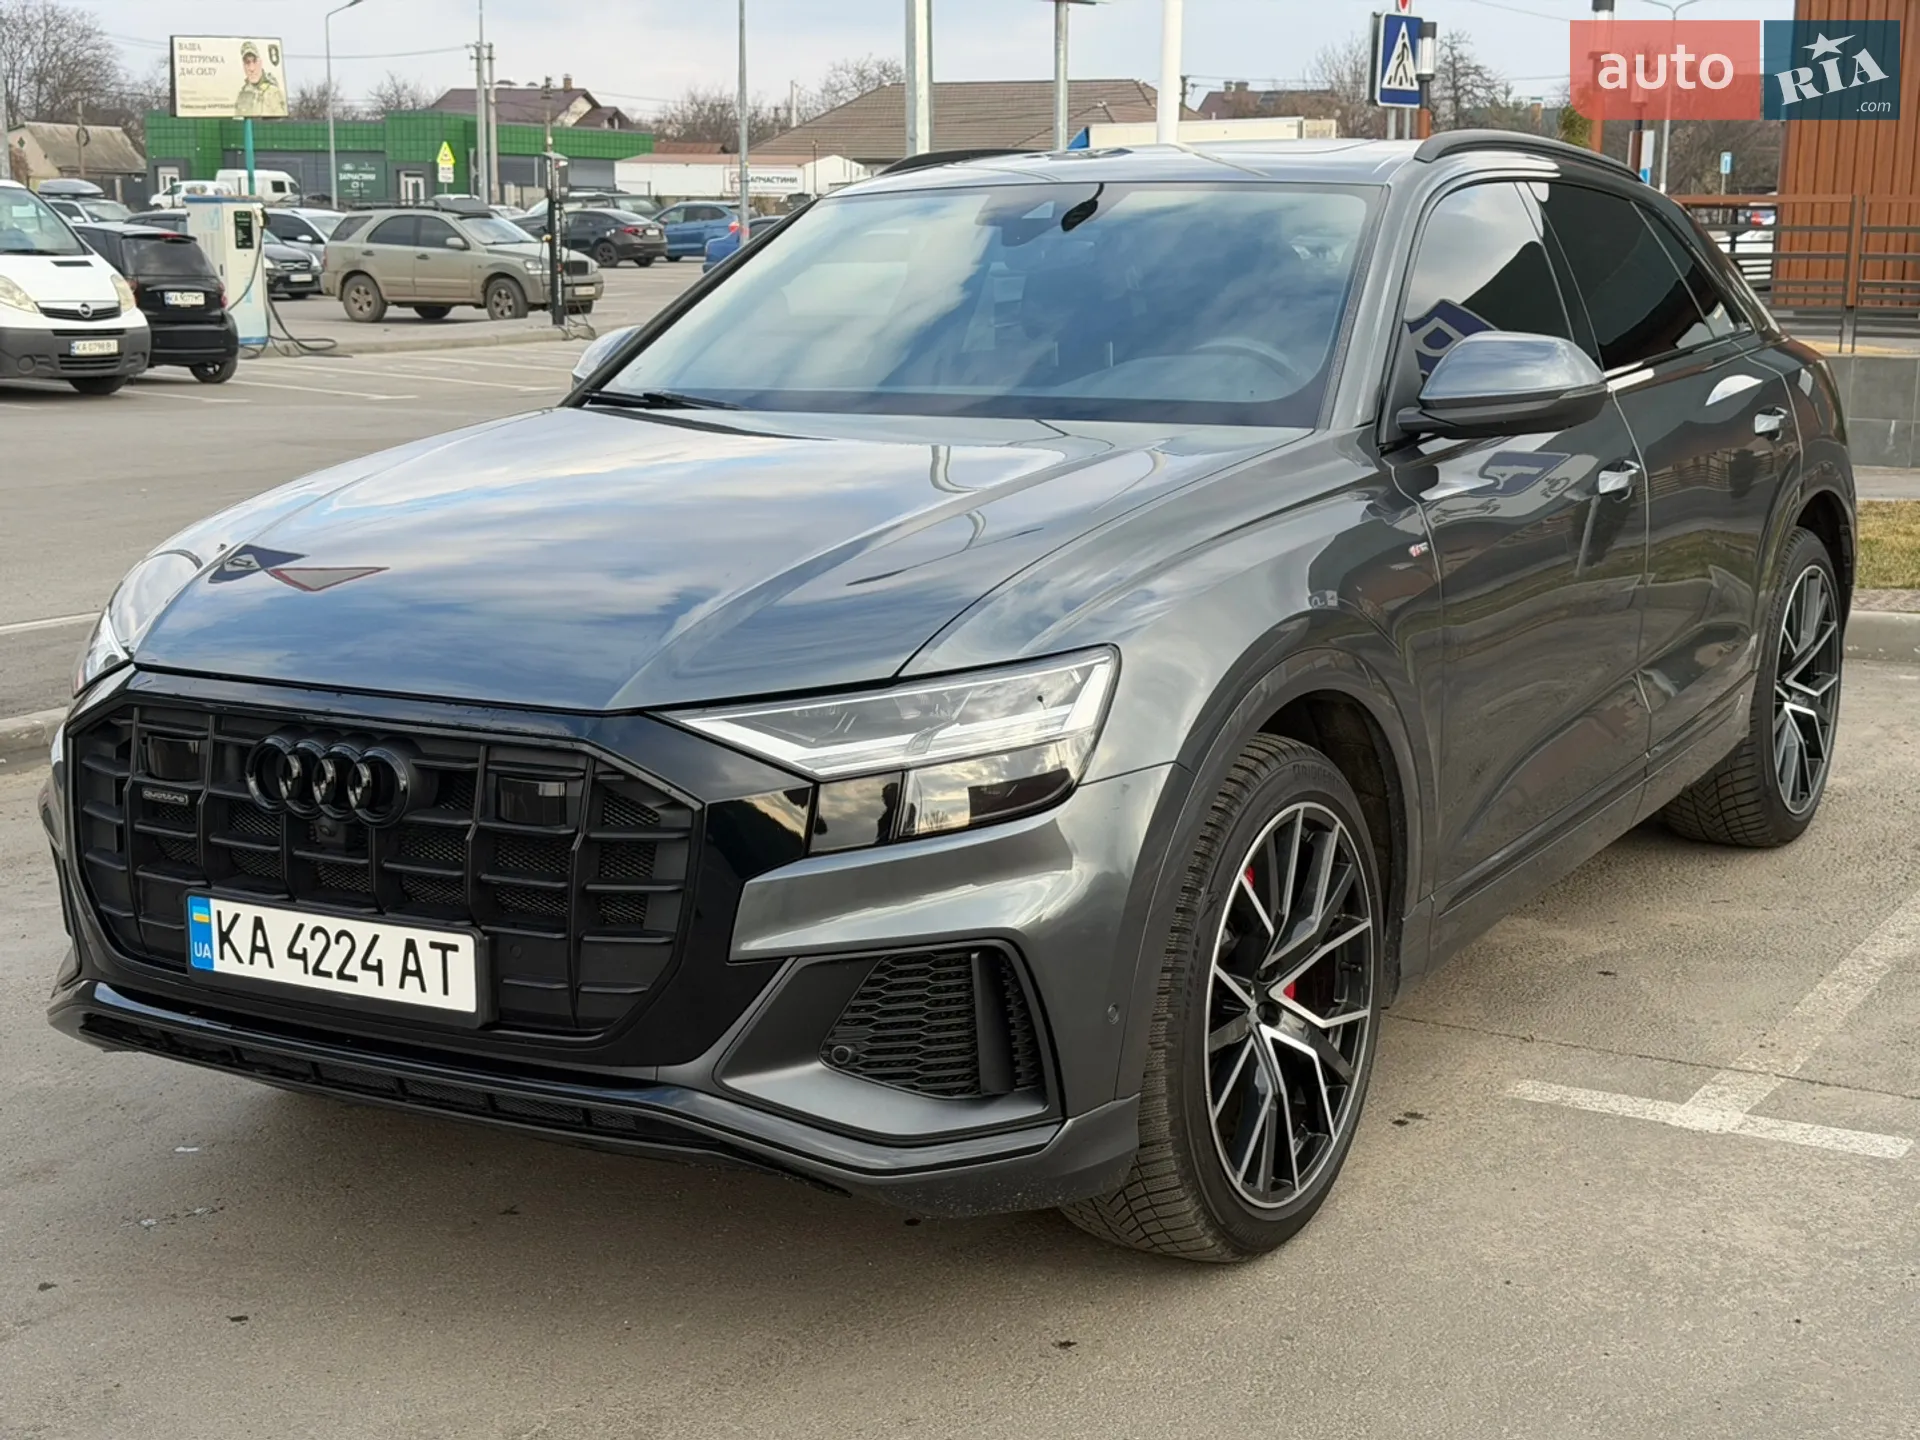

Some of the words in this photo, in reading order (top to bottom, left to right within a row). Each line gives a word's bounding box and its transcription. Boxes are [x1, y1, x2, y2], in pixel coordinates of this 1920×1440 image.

[194, 940, 212, 960] UA
[216, 909, 275, 969] KA
[286, 922, 384, 987] 4224
[398, 937, 460, 997] AT
